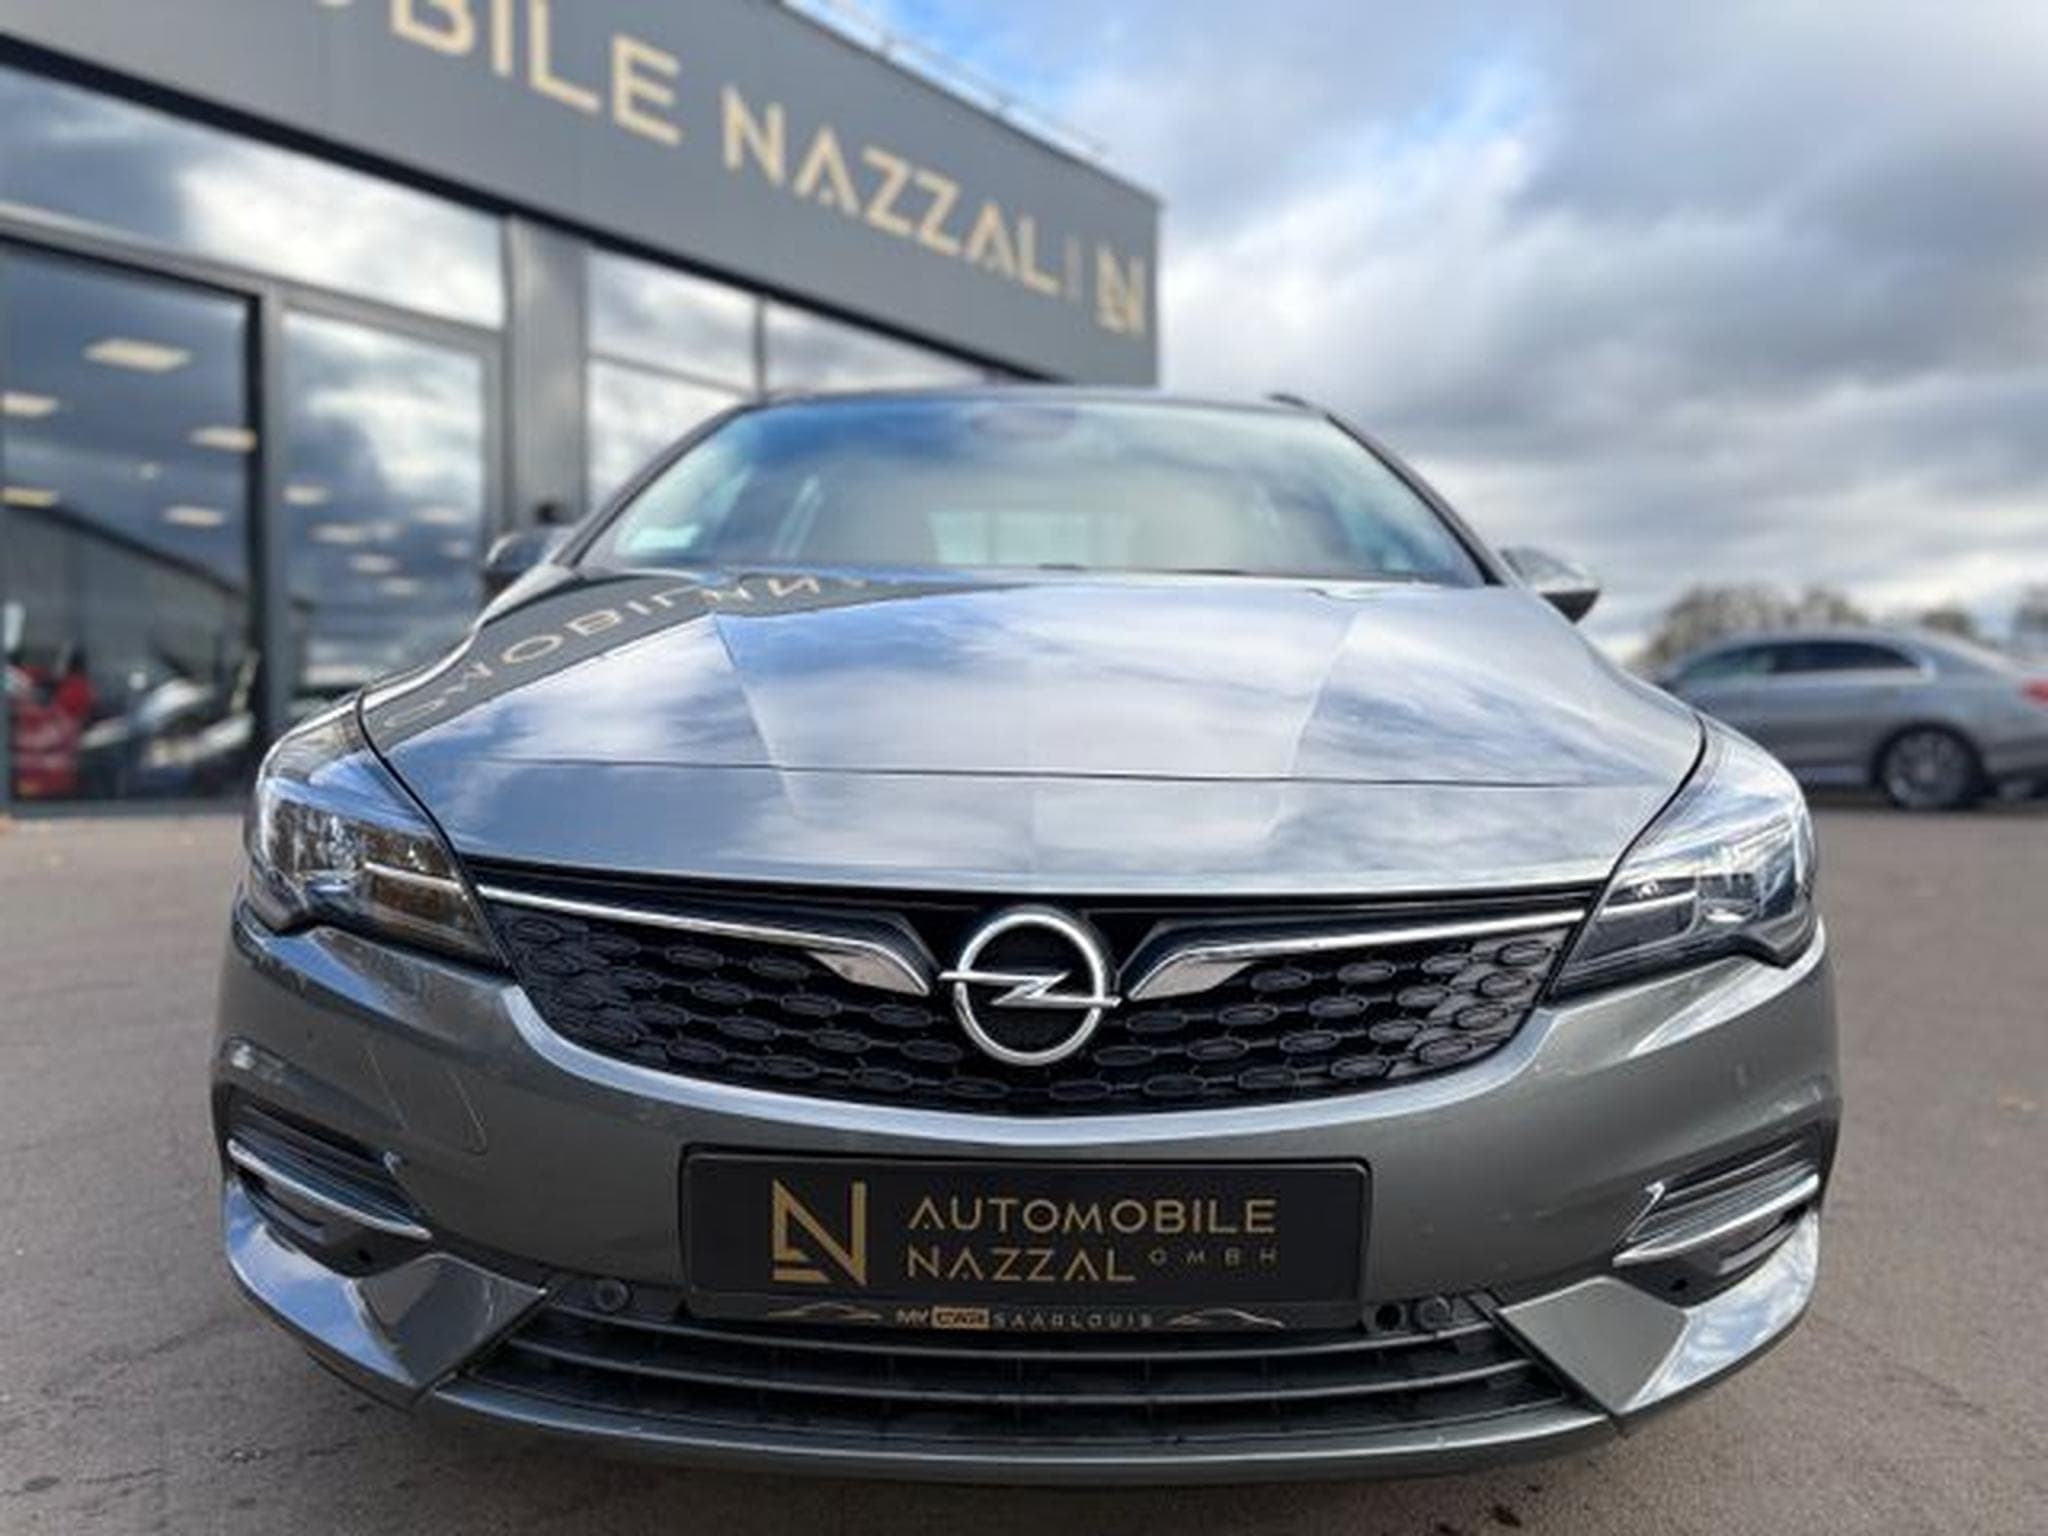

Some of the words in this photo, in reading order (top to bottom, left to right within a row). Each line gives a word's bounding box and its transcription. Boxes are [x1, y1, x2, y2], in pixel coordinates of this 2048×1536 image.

[318, 0, 684, 147] BILE
[722, 84, 1061, 297] NAZZAL
[907, 1196, 1278, 1235] AUTOMOBILE
[907, 1247, 1136, 1283] NAZZAL
[993, 1310, 1153, 1329] SAARLOUIS
